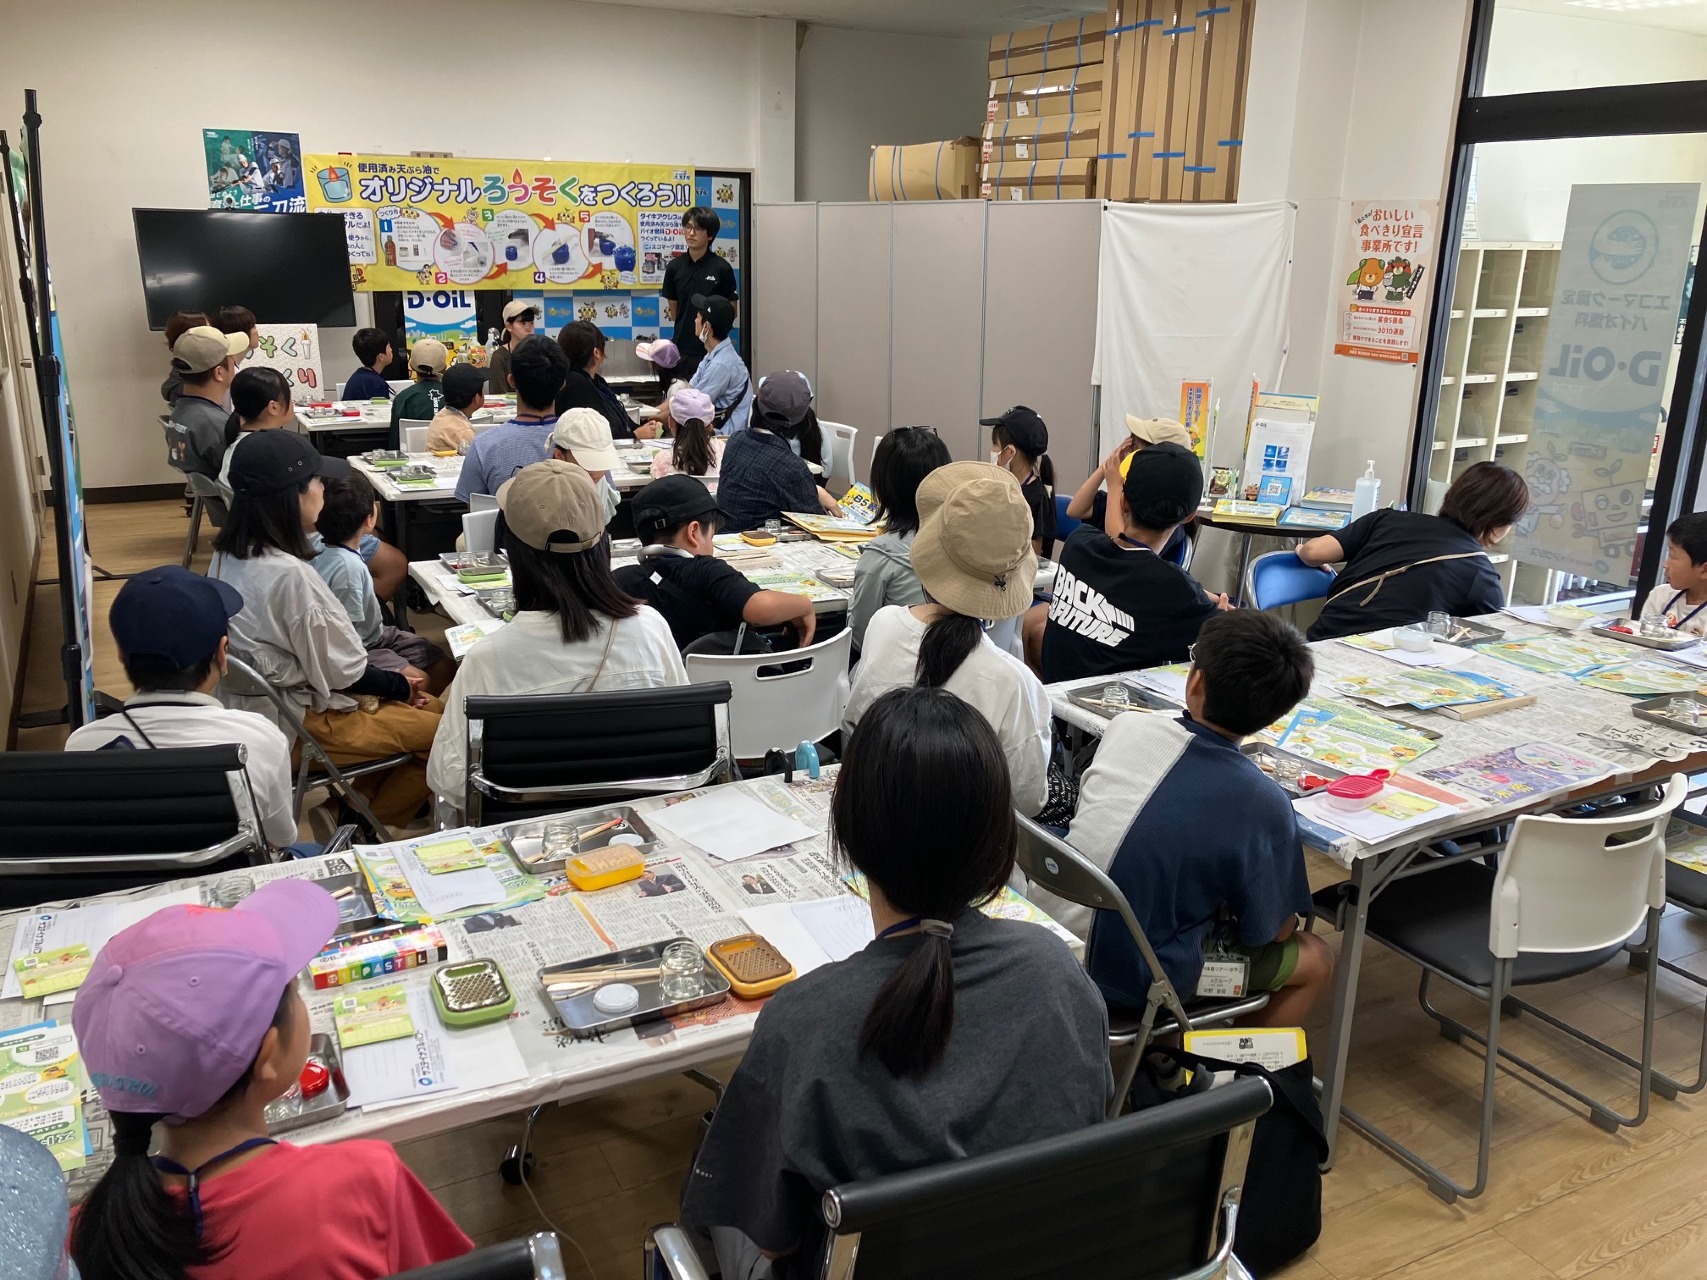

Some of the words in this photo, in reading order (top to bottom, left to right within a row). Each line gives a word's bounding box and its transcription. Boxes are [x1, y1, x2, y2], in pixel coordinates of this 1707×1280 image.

[358, 162, 440, 175] 使用済み天ぷら油で
[359, 174, 692, 208] オリジナルろうそくをつくろう!!
[378, 210, 399, 218] つくり方
[483, 210, 493, 220] 3
[579, 212, 590, 222] 5
[1372, 208, 1414, 222] おいしい
[345, 221, 371, 229] ルだよ!
[1359, 223, 1424, 239] 食べきり宣言
[1361, 239, 1418, 253] 事業所です!
[437, 273, 448, 283] 2
[534, 273, 546, 282] 4
[1052, 563, 1111, 627] BACK
[1053, 599, 1131, 648] FUTURE
[362, 953, 427, 977] PASTEL
